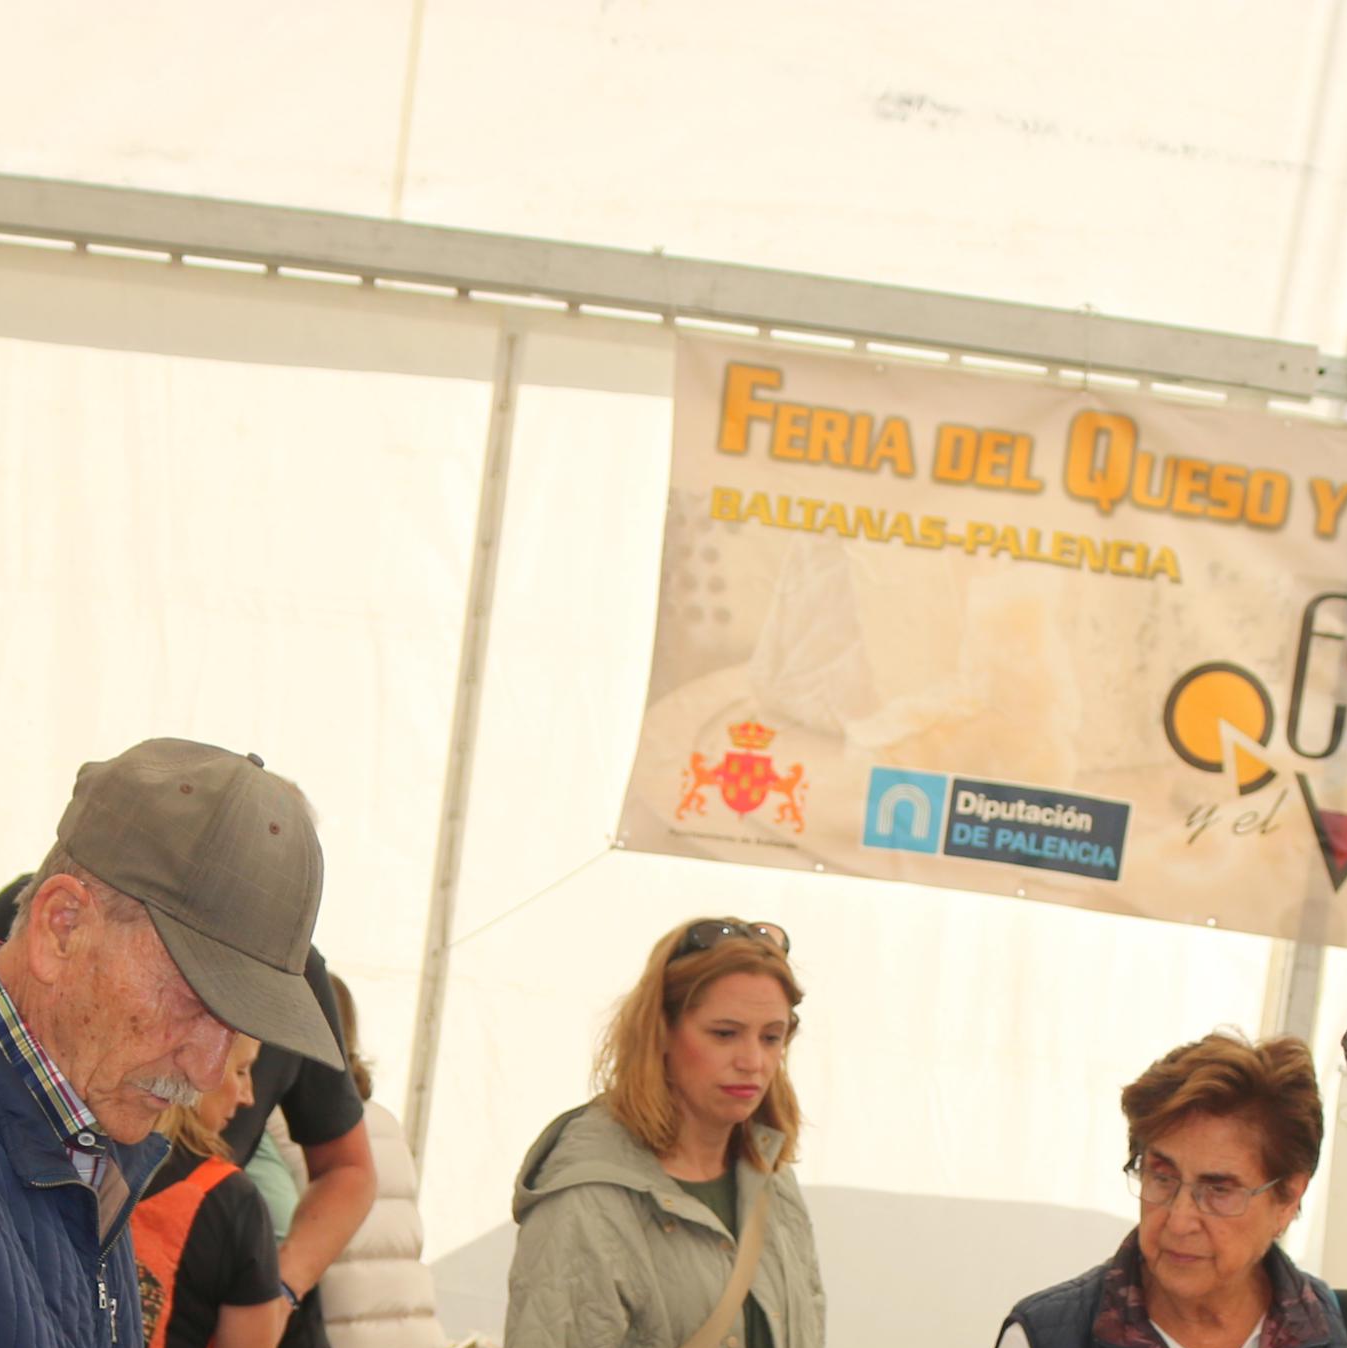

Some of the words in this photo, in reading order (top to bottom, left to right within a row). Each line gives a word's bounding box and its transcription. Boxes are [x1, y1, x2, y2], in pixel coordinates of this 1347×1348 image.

[716, 361, 915, 476] FERIA
[931, 422, 1044, 494] DEL
[1062, 408, 1291, 532] QUESO
[709, 486, 1182, 584] BALTANAS-PALENCIA
[955, 790, 1094, 832] Diputación
[1184, 802, 1220, 846] y
[1231, 787, 1289, 836] el
[952, 822, 990, 849] DE
[997, 827, 1118, 869] PALENCIA
